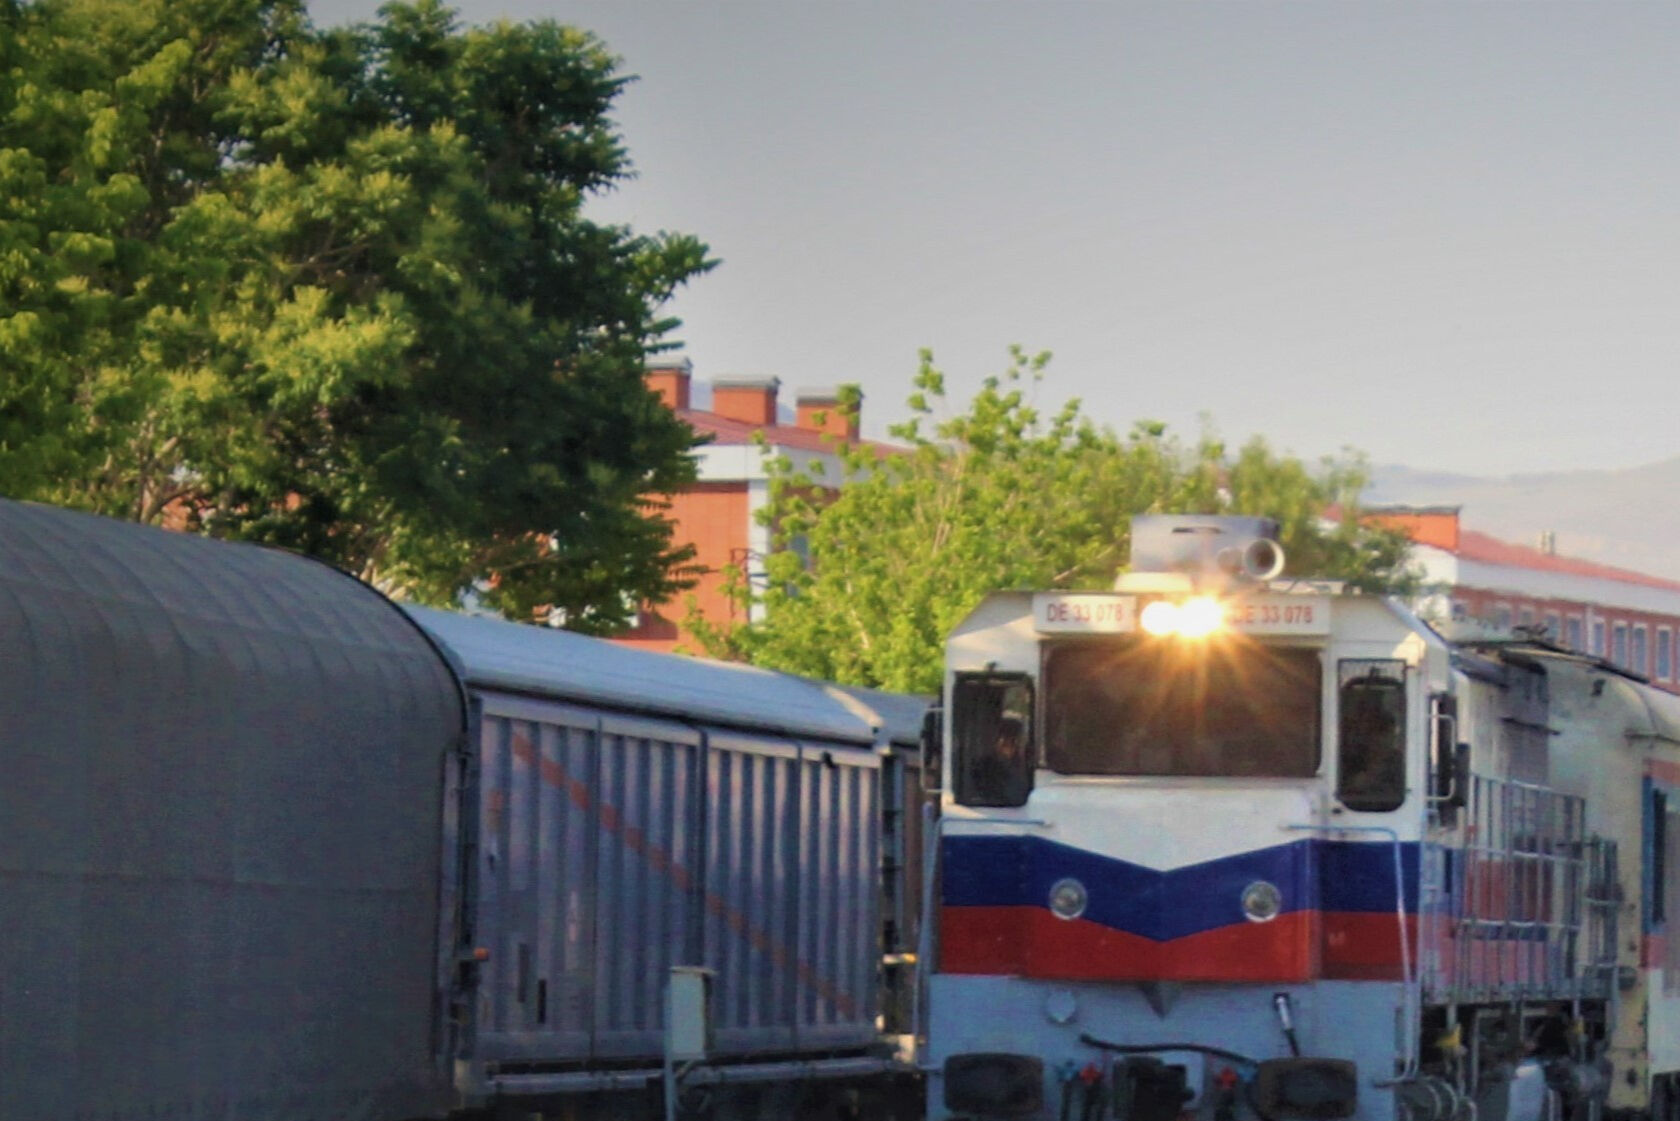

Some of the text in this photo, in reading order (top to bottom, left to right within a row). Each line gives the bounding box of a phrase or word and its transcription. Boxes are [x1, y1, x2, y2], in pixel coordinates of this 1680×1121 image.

[1047, 603, 1068, 622] DE
[1073, 603, 1090, 622] 33
[1261, 605, 1280, 624] 33
[1284, 605, 1313, 624] 078
